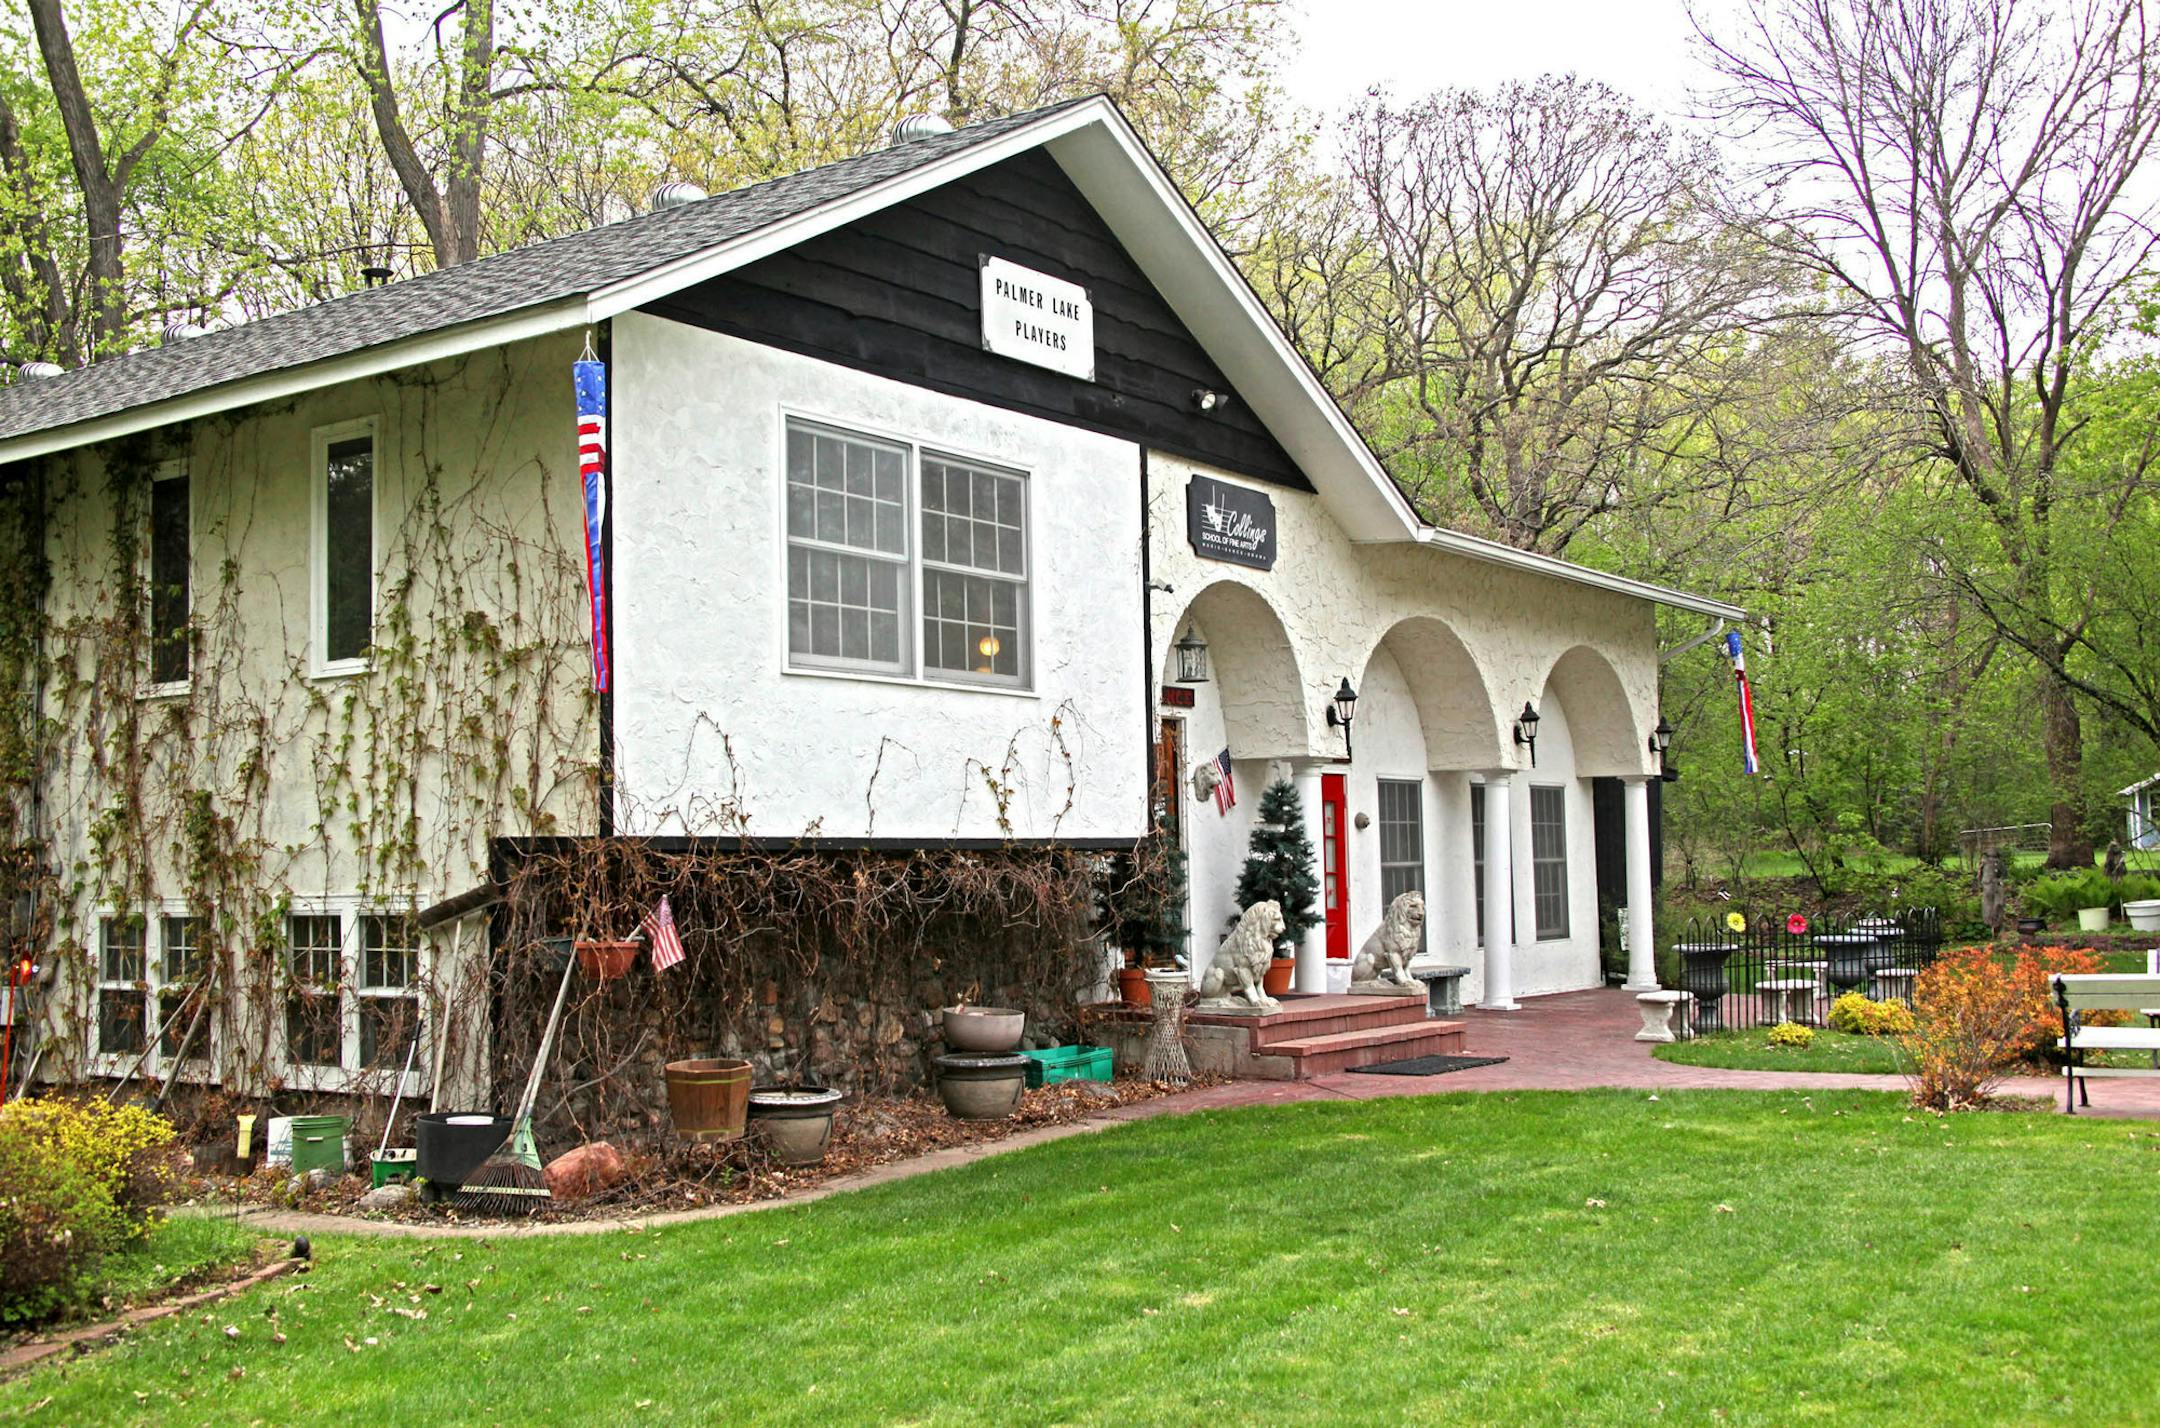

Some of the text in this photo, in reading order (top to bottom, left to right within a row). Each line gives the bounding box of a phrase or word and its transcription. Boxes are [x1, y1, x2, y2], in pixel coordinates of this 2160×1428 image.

[996, 278, 1080, 321] PALMER LAKE
[1015, 320, 1067, 351] PLAYERS
[1202, 531, 1222, 544] SCHOOL
[1222, 536, 1229, 545] OF
[1227, 511, 1267, 550] Collings
